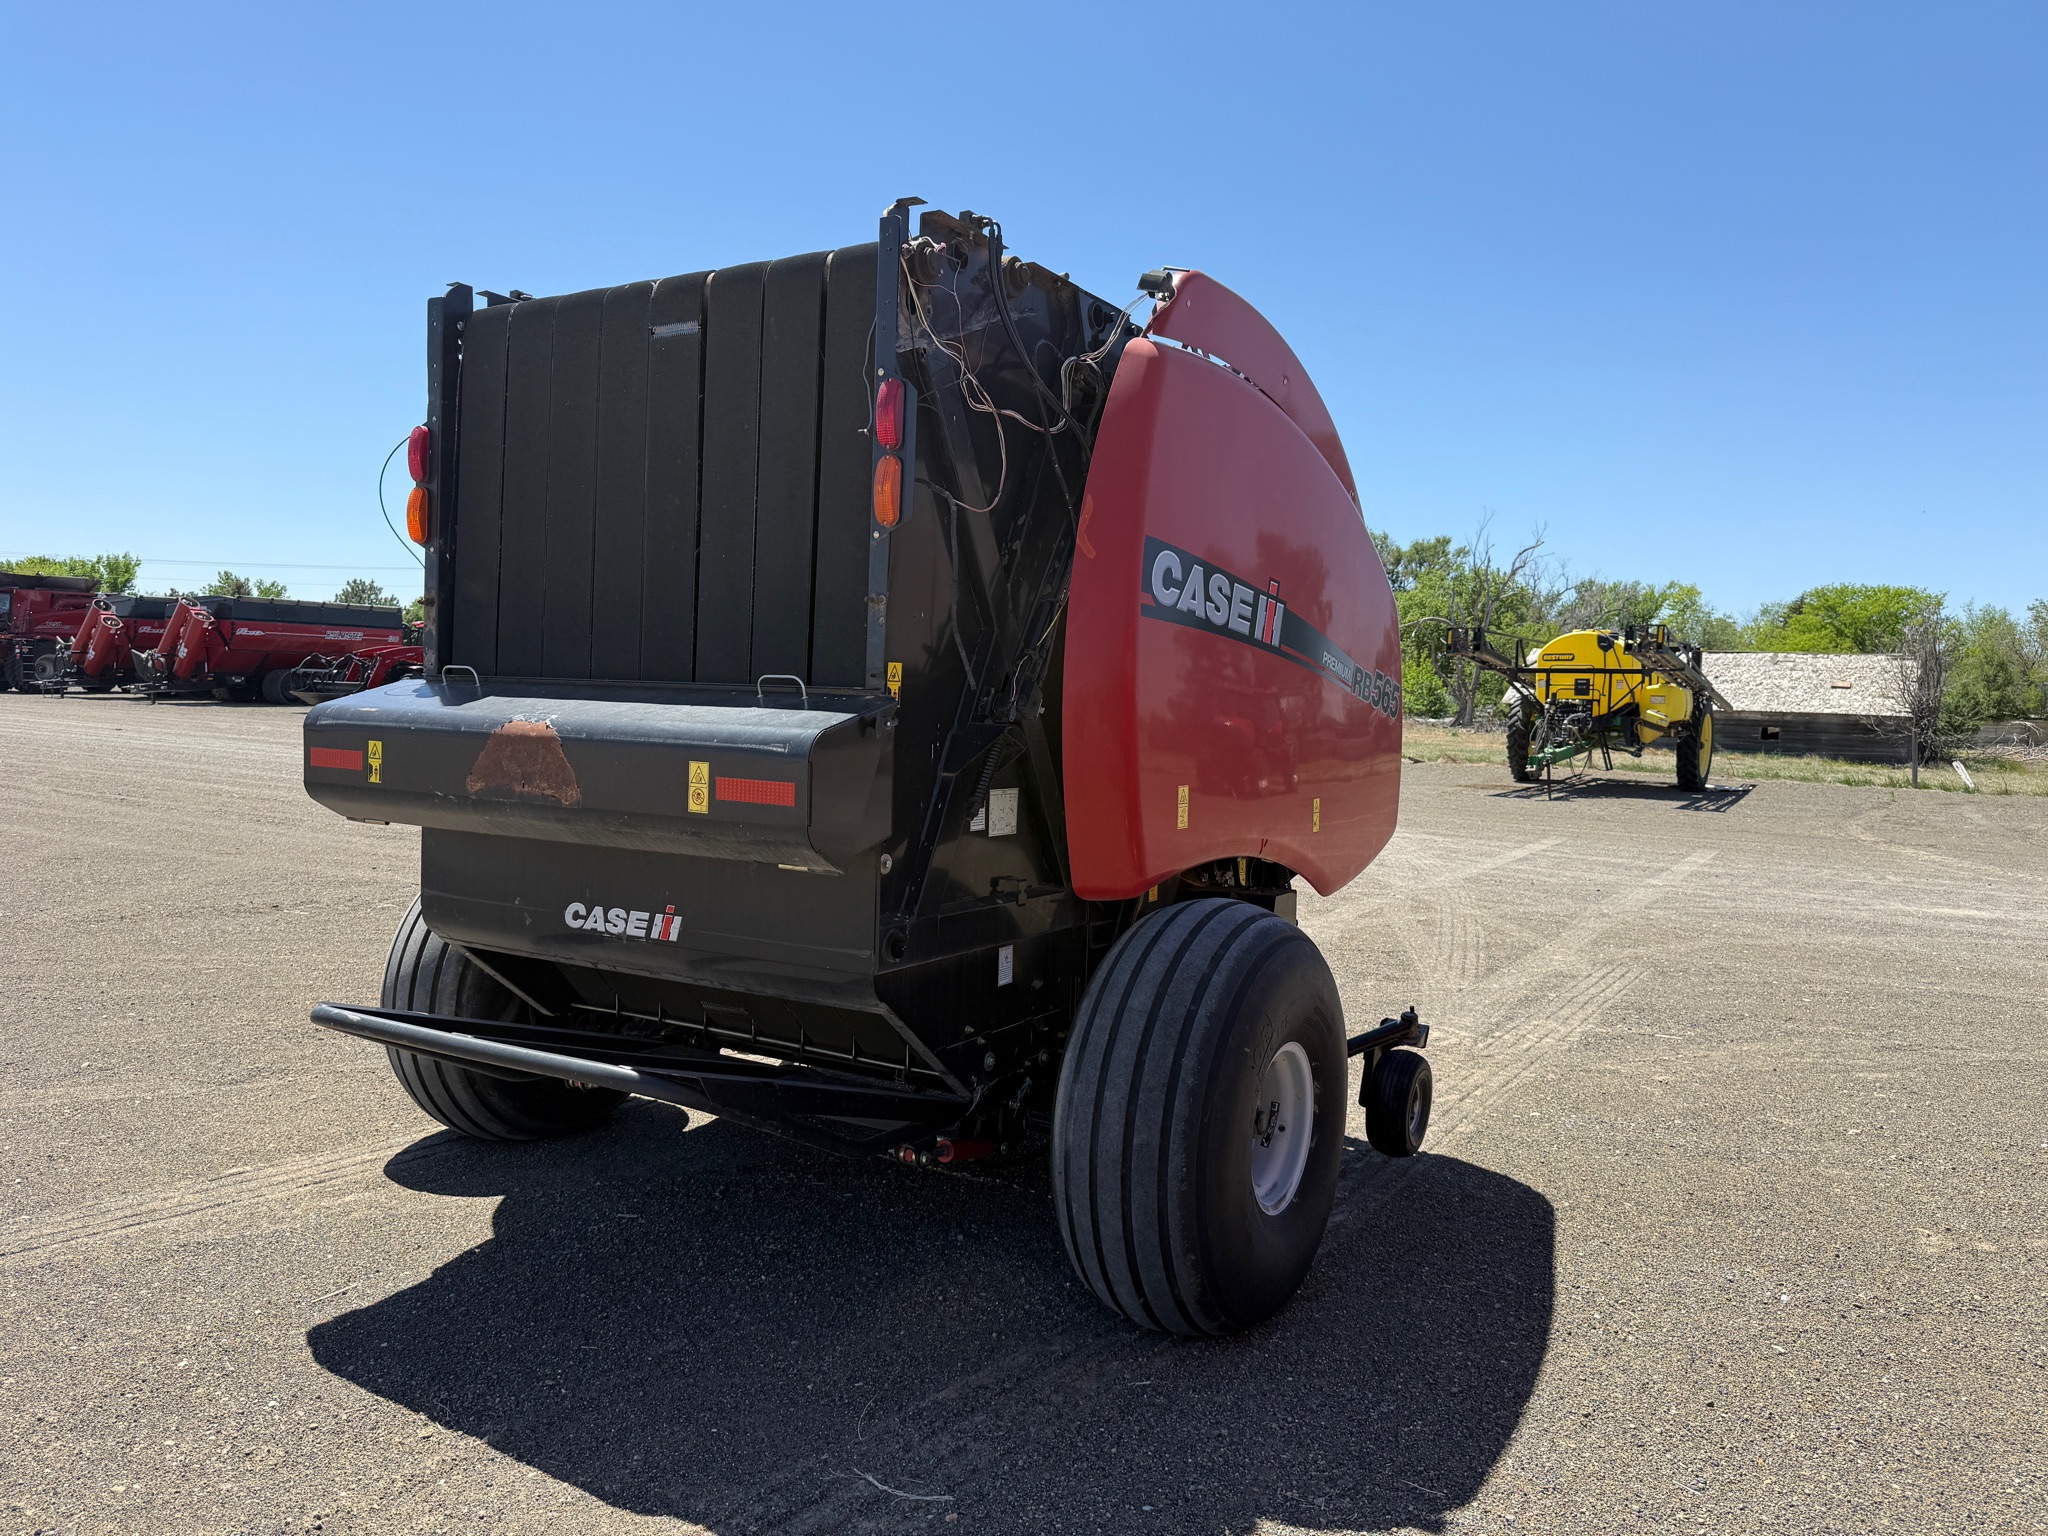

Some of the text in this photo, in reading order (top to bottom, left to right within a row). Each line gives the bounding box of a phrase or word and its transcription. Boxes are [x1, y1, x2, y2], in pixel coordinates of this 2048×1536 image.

[1151, 549, 1255, 636] CASE
[1321, 650, 1401, 720] PREMIUM RB565
[564, 902, 651, 938] CASE
